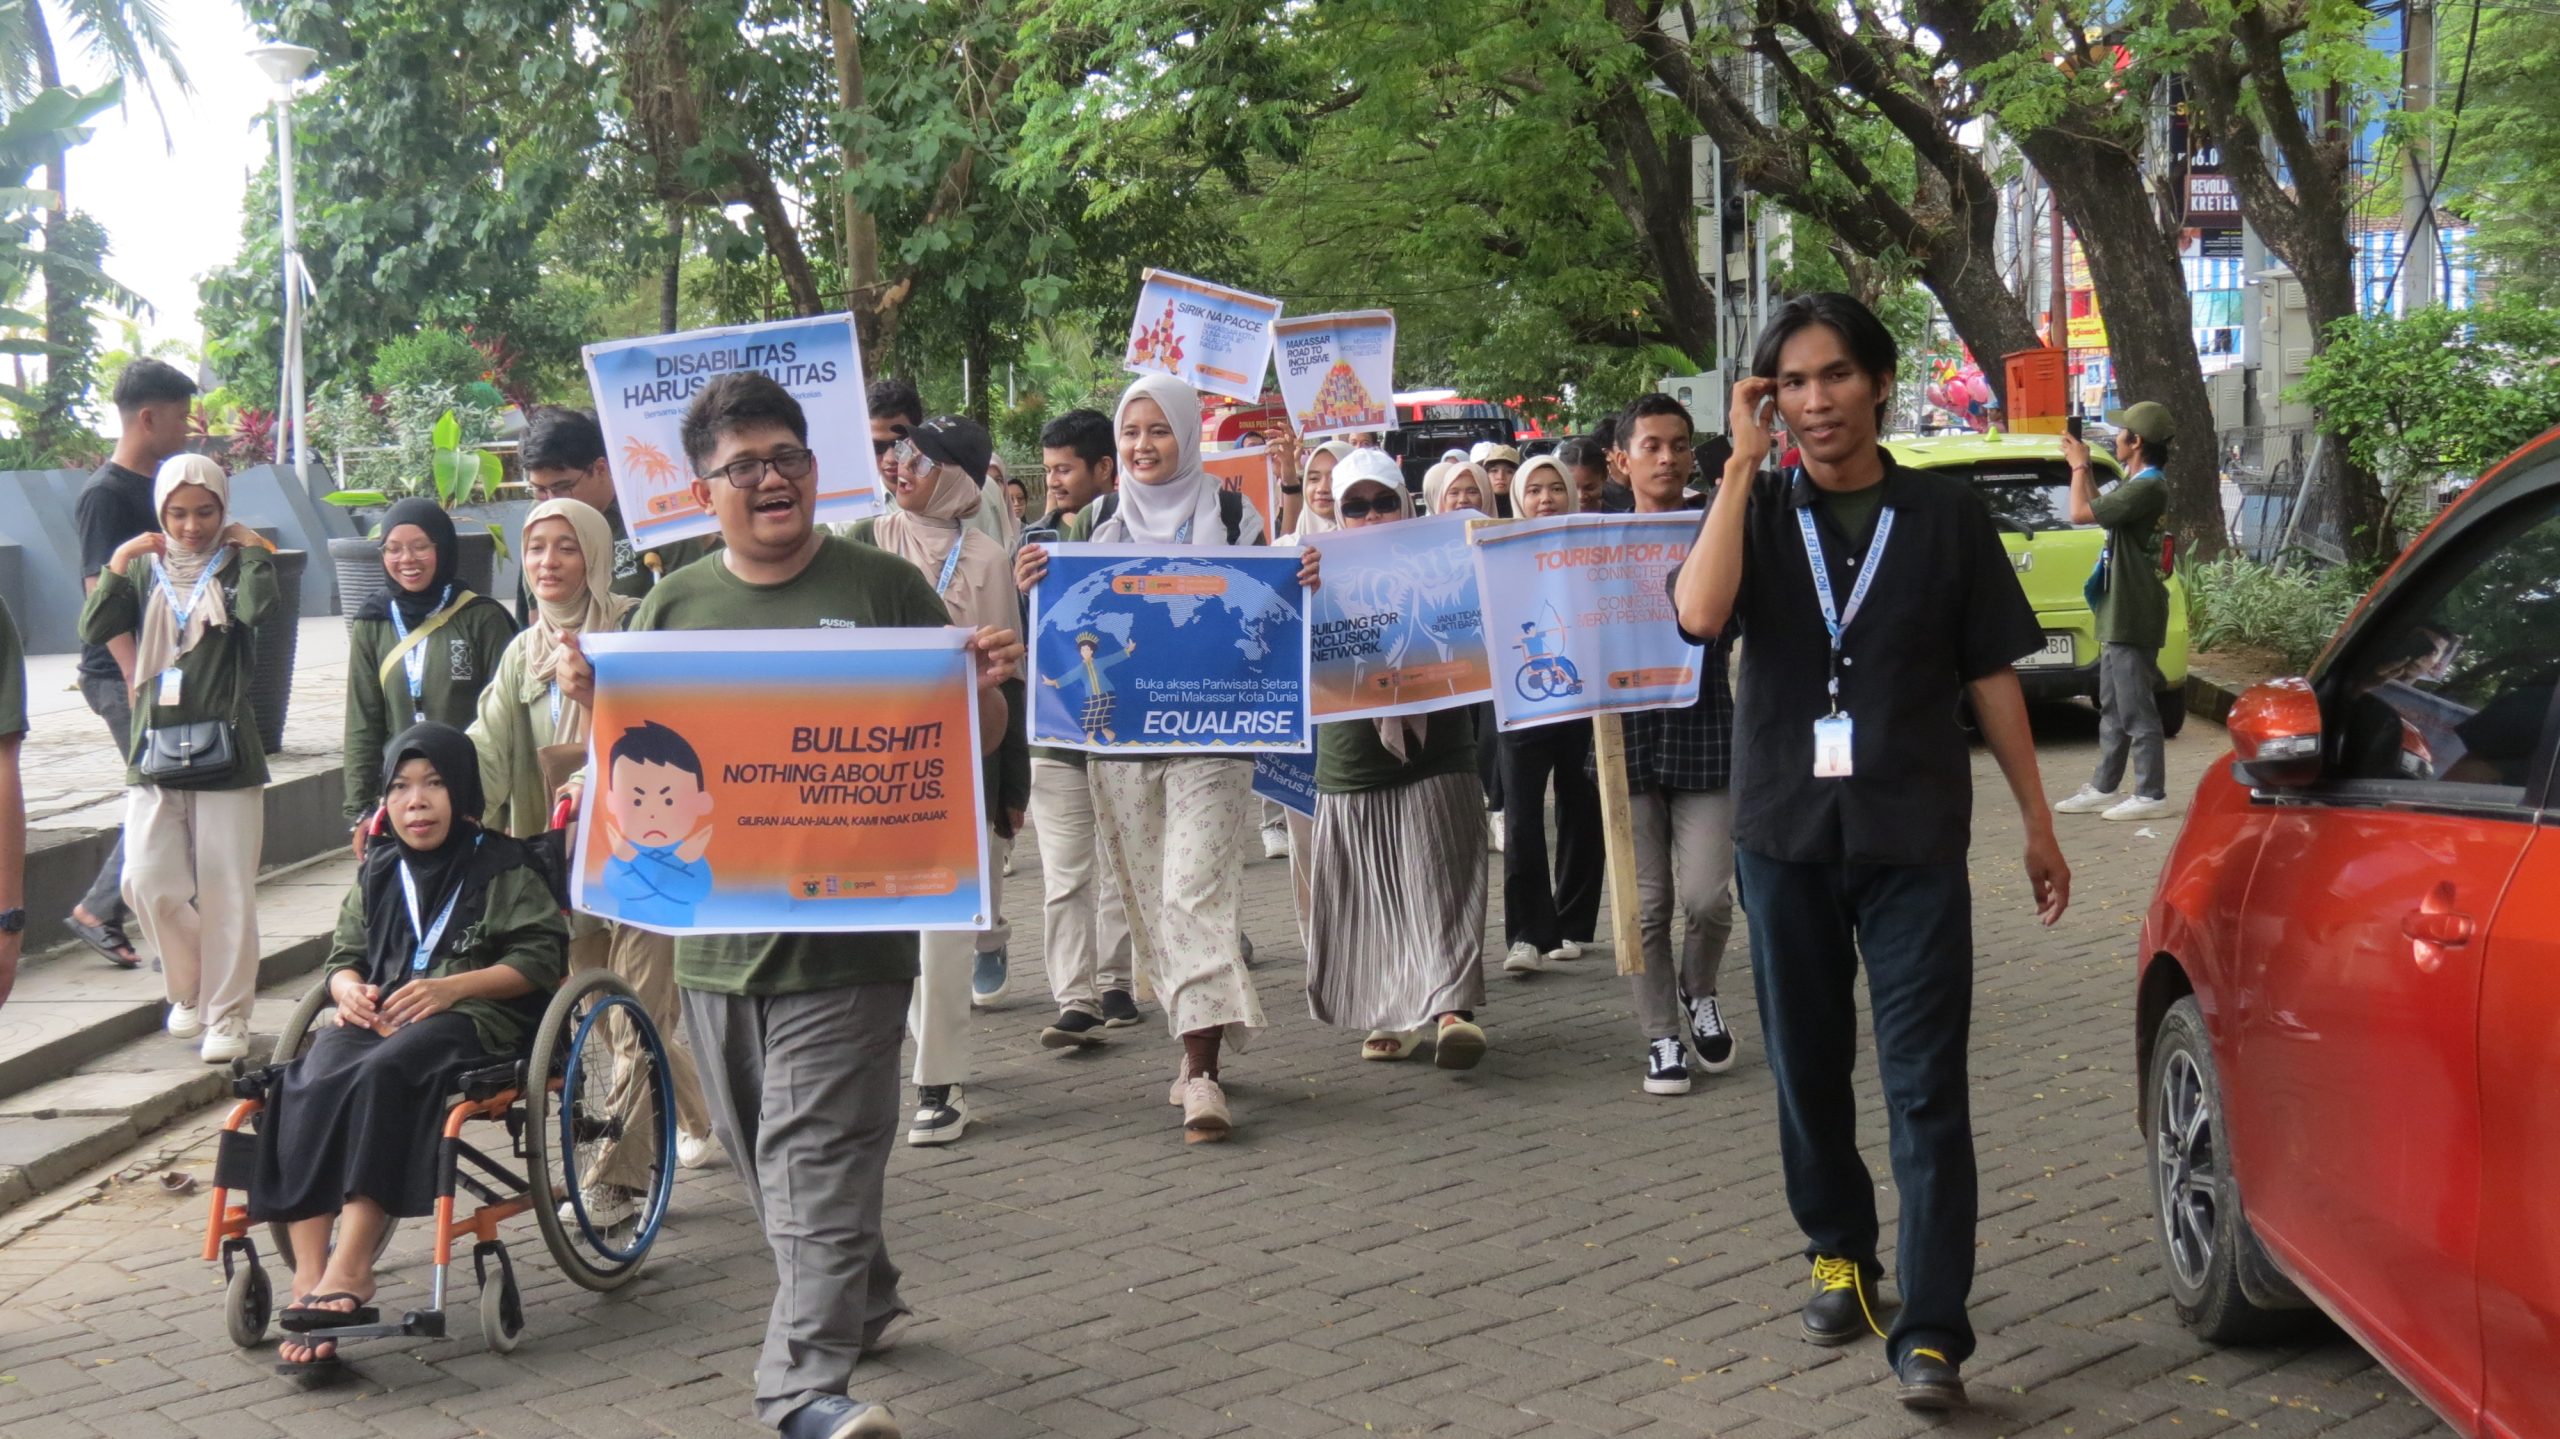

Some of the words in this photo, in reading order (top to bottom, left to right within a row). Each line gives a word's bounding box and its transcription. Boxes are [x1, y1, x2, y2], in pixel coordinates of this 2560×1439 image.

[2191, 179, 2232, 194] REVOLU
[2191, 196, 2238, 211] KRETEK
[1177, 302, 1206, 318] SIRIK
[1206, 310, 1222, 322] NA
[1223, 314, 1263, 333] PACCE
[1286, 335, 1330, 349] MAKASSAR
[1287, 347, 1310, 358] ROAD
[1311, 346, 1323, 355] TO
[655, 341, 797, 378] DISABILITAS
[1289, 353, 1330, 367] INCLUSIVE
[1290, 366, 1309, 376] CITY
[623, 376, 705, 409] HARUS
[644, 407, 678, 419] Bersama
[1805, 531, 1819, 553] LEFT
[1534, 546, 1623, 572] TOURISM
[1625, 543, 1664, 561] FOR
[1666, 543, 1690, 561] AL
[1811, 554, 1824, 574] ONE
[1854, 573, 1870, 599] PUSAT
[1865, 530, 1886, 574] DISABILITAS
[1816, 576, 1829, 591] NO
[820, 618, 856, 628] PUSDIS
[1310, 616, 1368, 636] BUILDING
[1371, 612, 1399, 626] FOR
[1432, 620, 1457, 633] BUKTI
[1311, 628, 1381, 650] NCLUSION
[1135, 678, 1164, 690] Buka
[1166, 678, 1200, 690] akses
[1202, 678, 1259, 690] Pariwisata
[1261, 678, 1298, 690] Setara
[1150, 691, 1180, 702] Demi
[1181, 691, 1237, 703] Makassar
[1238, 691, 1265, 703] Kota
[1266, 691, 1298, 703] Dunia
[1143, 710, 1293, 736] EQUALRISE
[791, 721, 942, 753] BULLSHIT!
[723, 763, 827, 783] NOTHING
[830, 762, 910, 783] ABOUT
[913, 758, 944, 779] US
[1268, 766, 1305, 793] harus
[800, 783, 908, 804] WITHOUT
[910, 780, 945, 801] US.
[737, 816, 778, 826] GILIRAN
[779, 816, 850, 827] JALAN-JALAN,
[851, 816, 878, 826] KAMI
[880, 814, 911, 825] NDAK
[912, 810, 948, 822] DIAJAK
